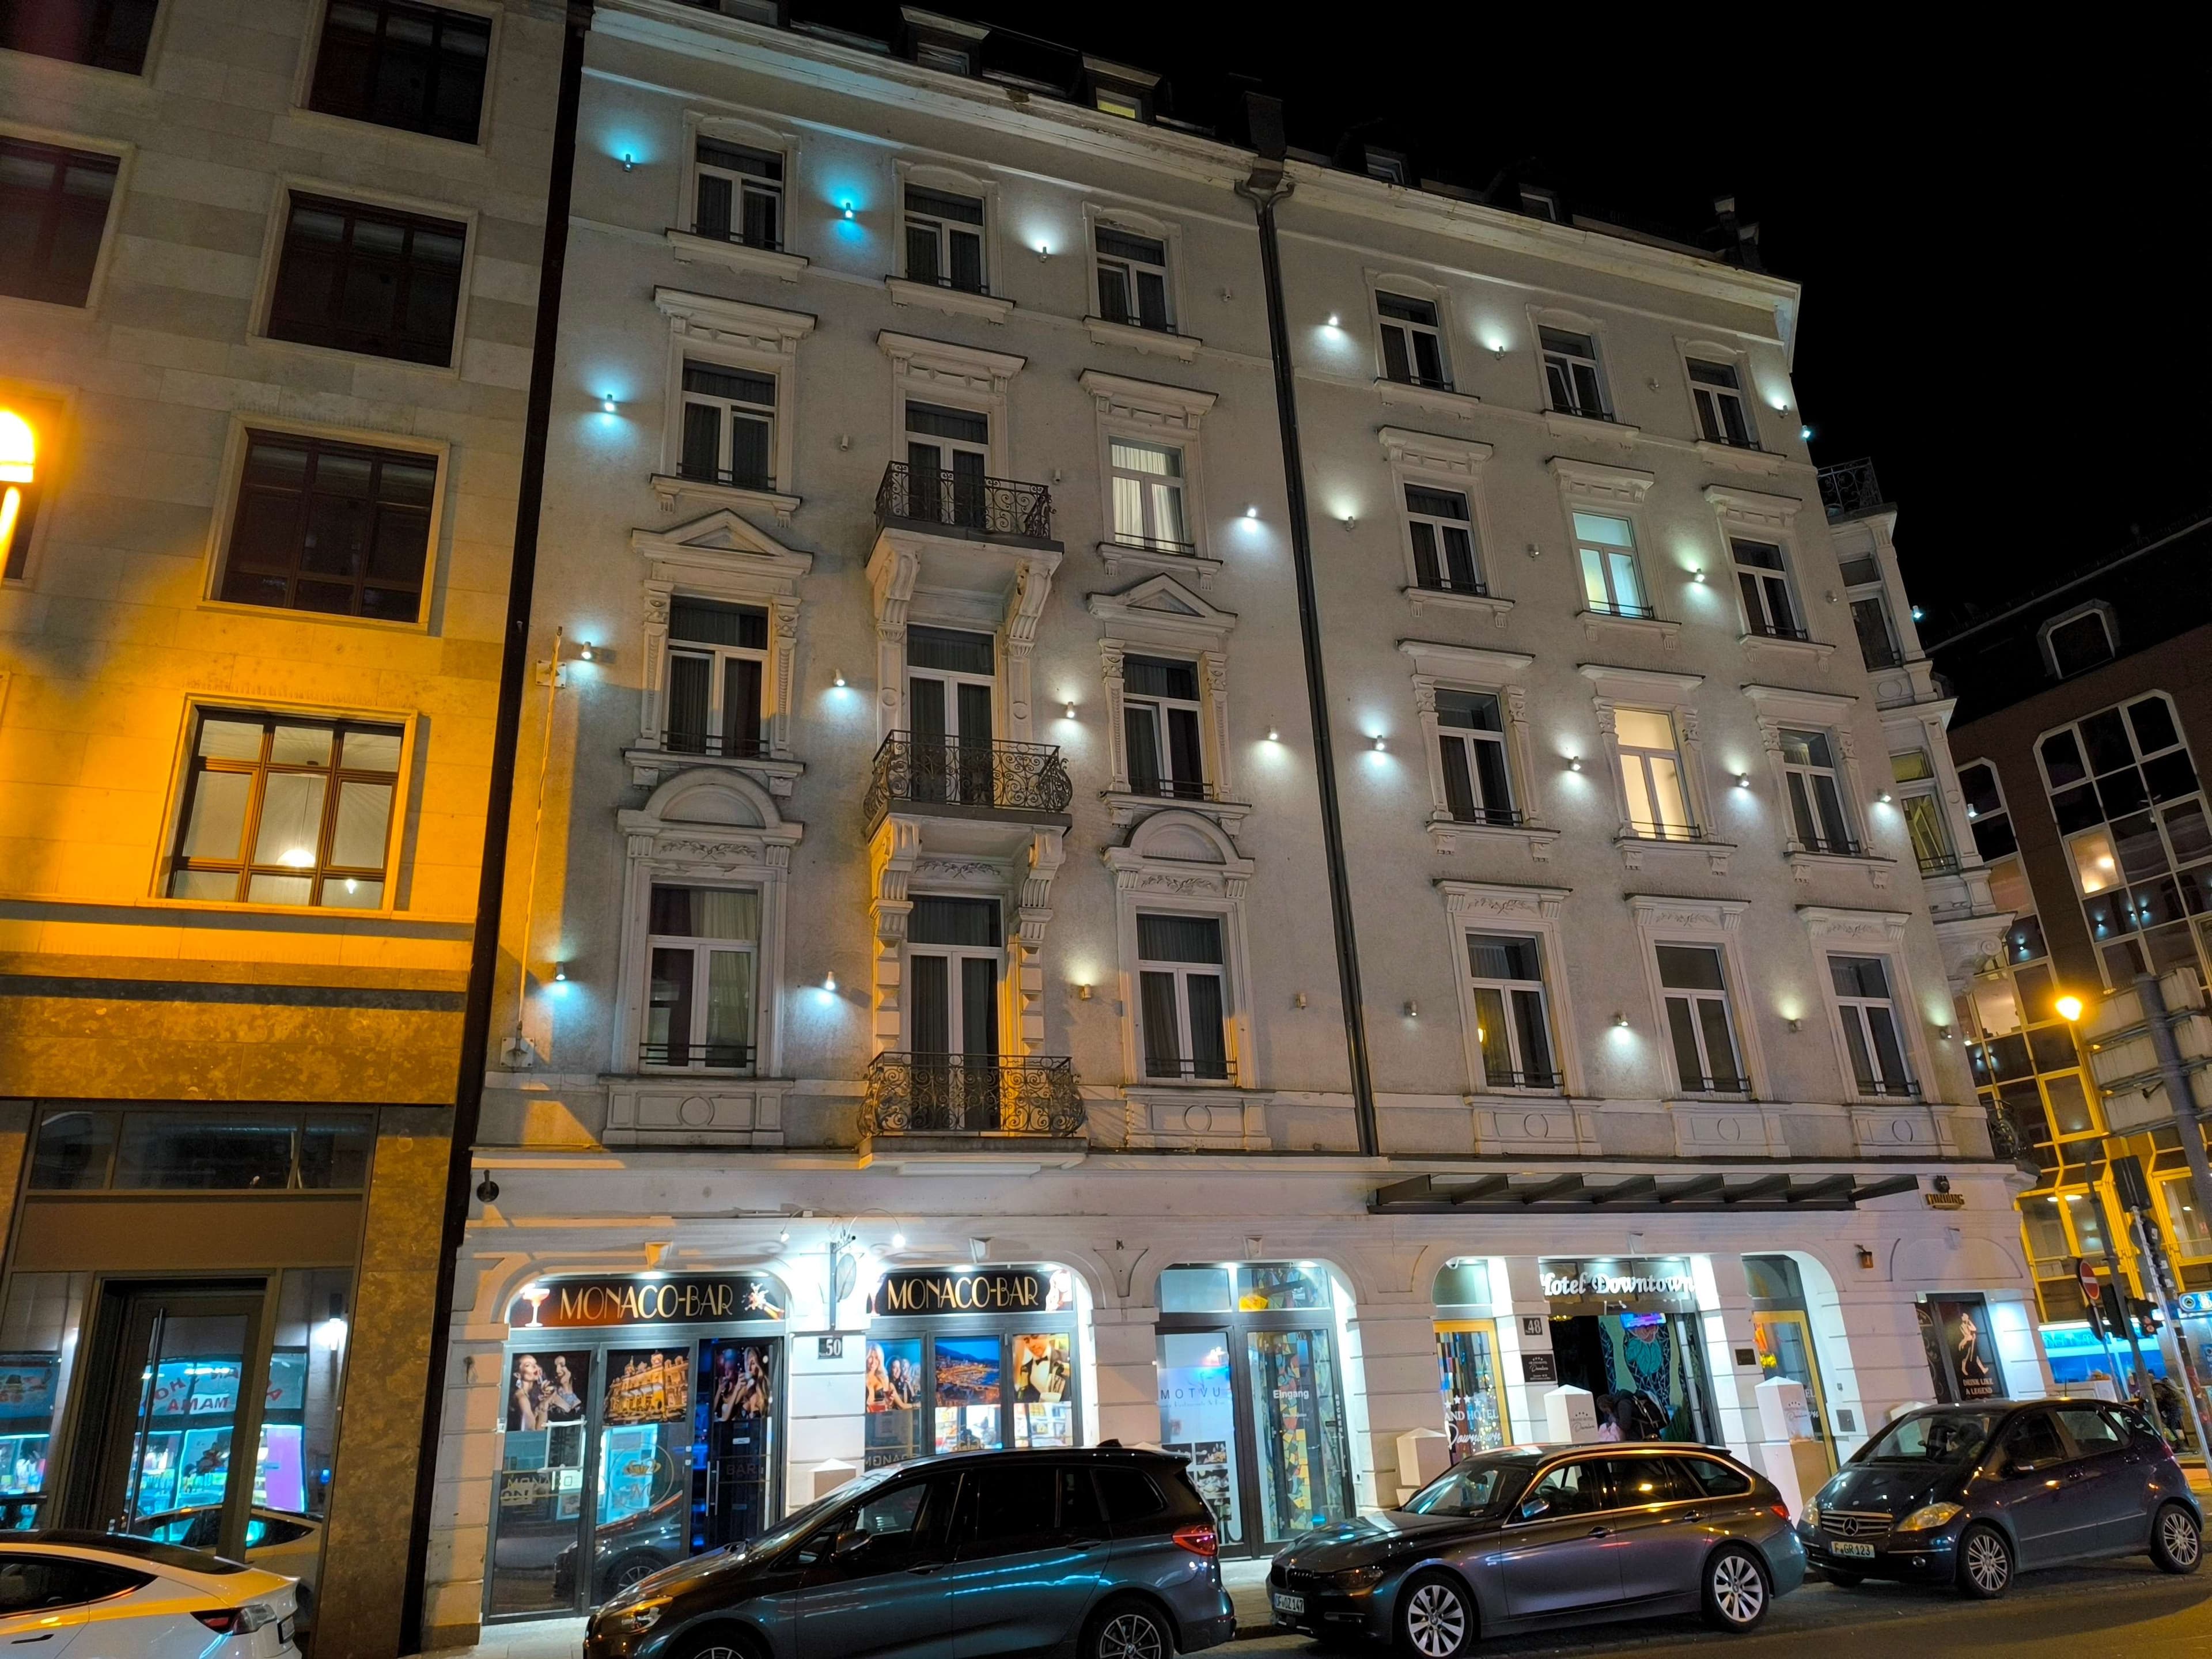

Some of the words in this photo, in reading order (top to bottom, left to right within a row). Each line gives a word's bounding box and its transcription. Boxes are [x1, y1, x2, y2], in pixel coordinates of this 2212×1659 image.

[1591, 1273, 1696, 1294] Downtown
[888, 1276, 1039, 1310] MONACO-BAR
[559, 1284, 733, 1320] MONACO-BAR
[1528, 1319, 1541, 1334] 48
[825, 1339, 842, 1356] 50
[1272, 1389, 1309, 1400] Eingang
[1855, 1545, 1871, 1556] 123
